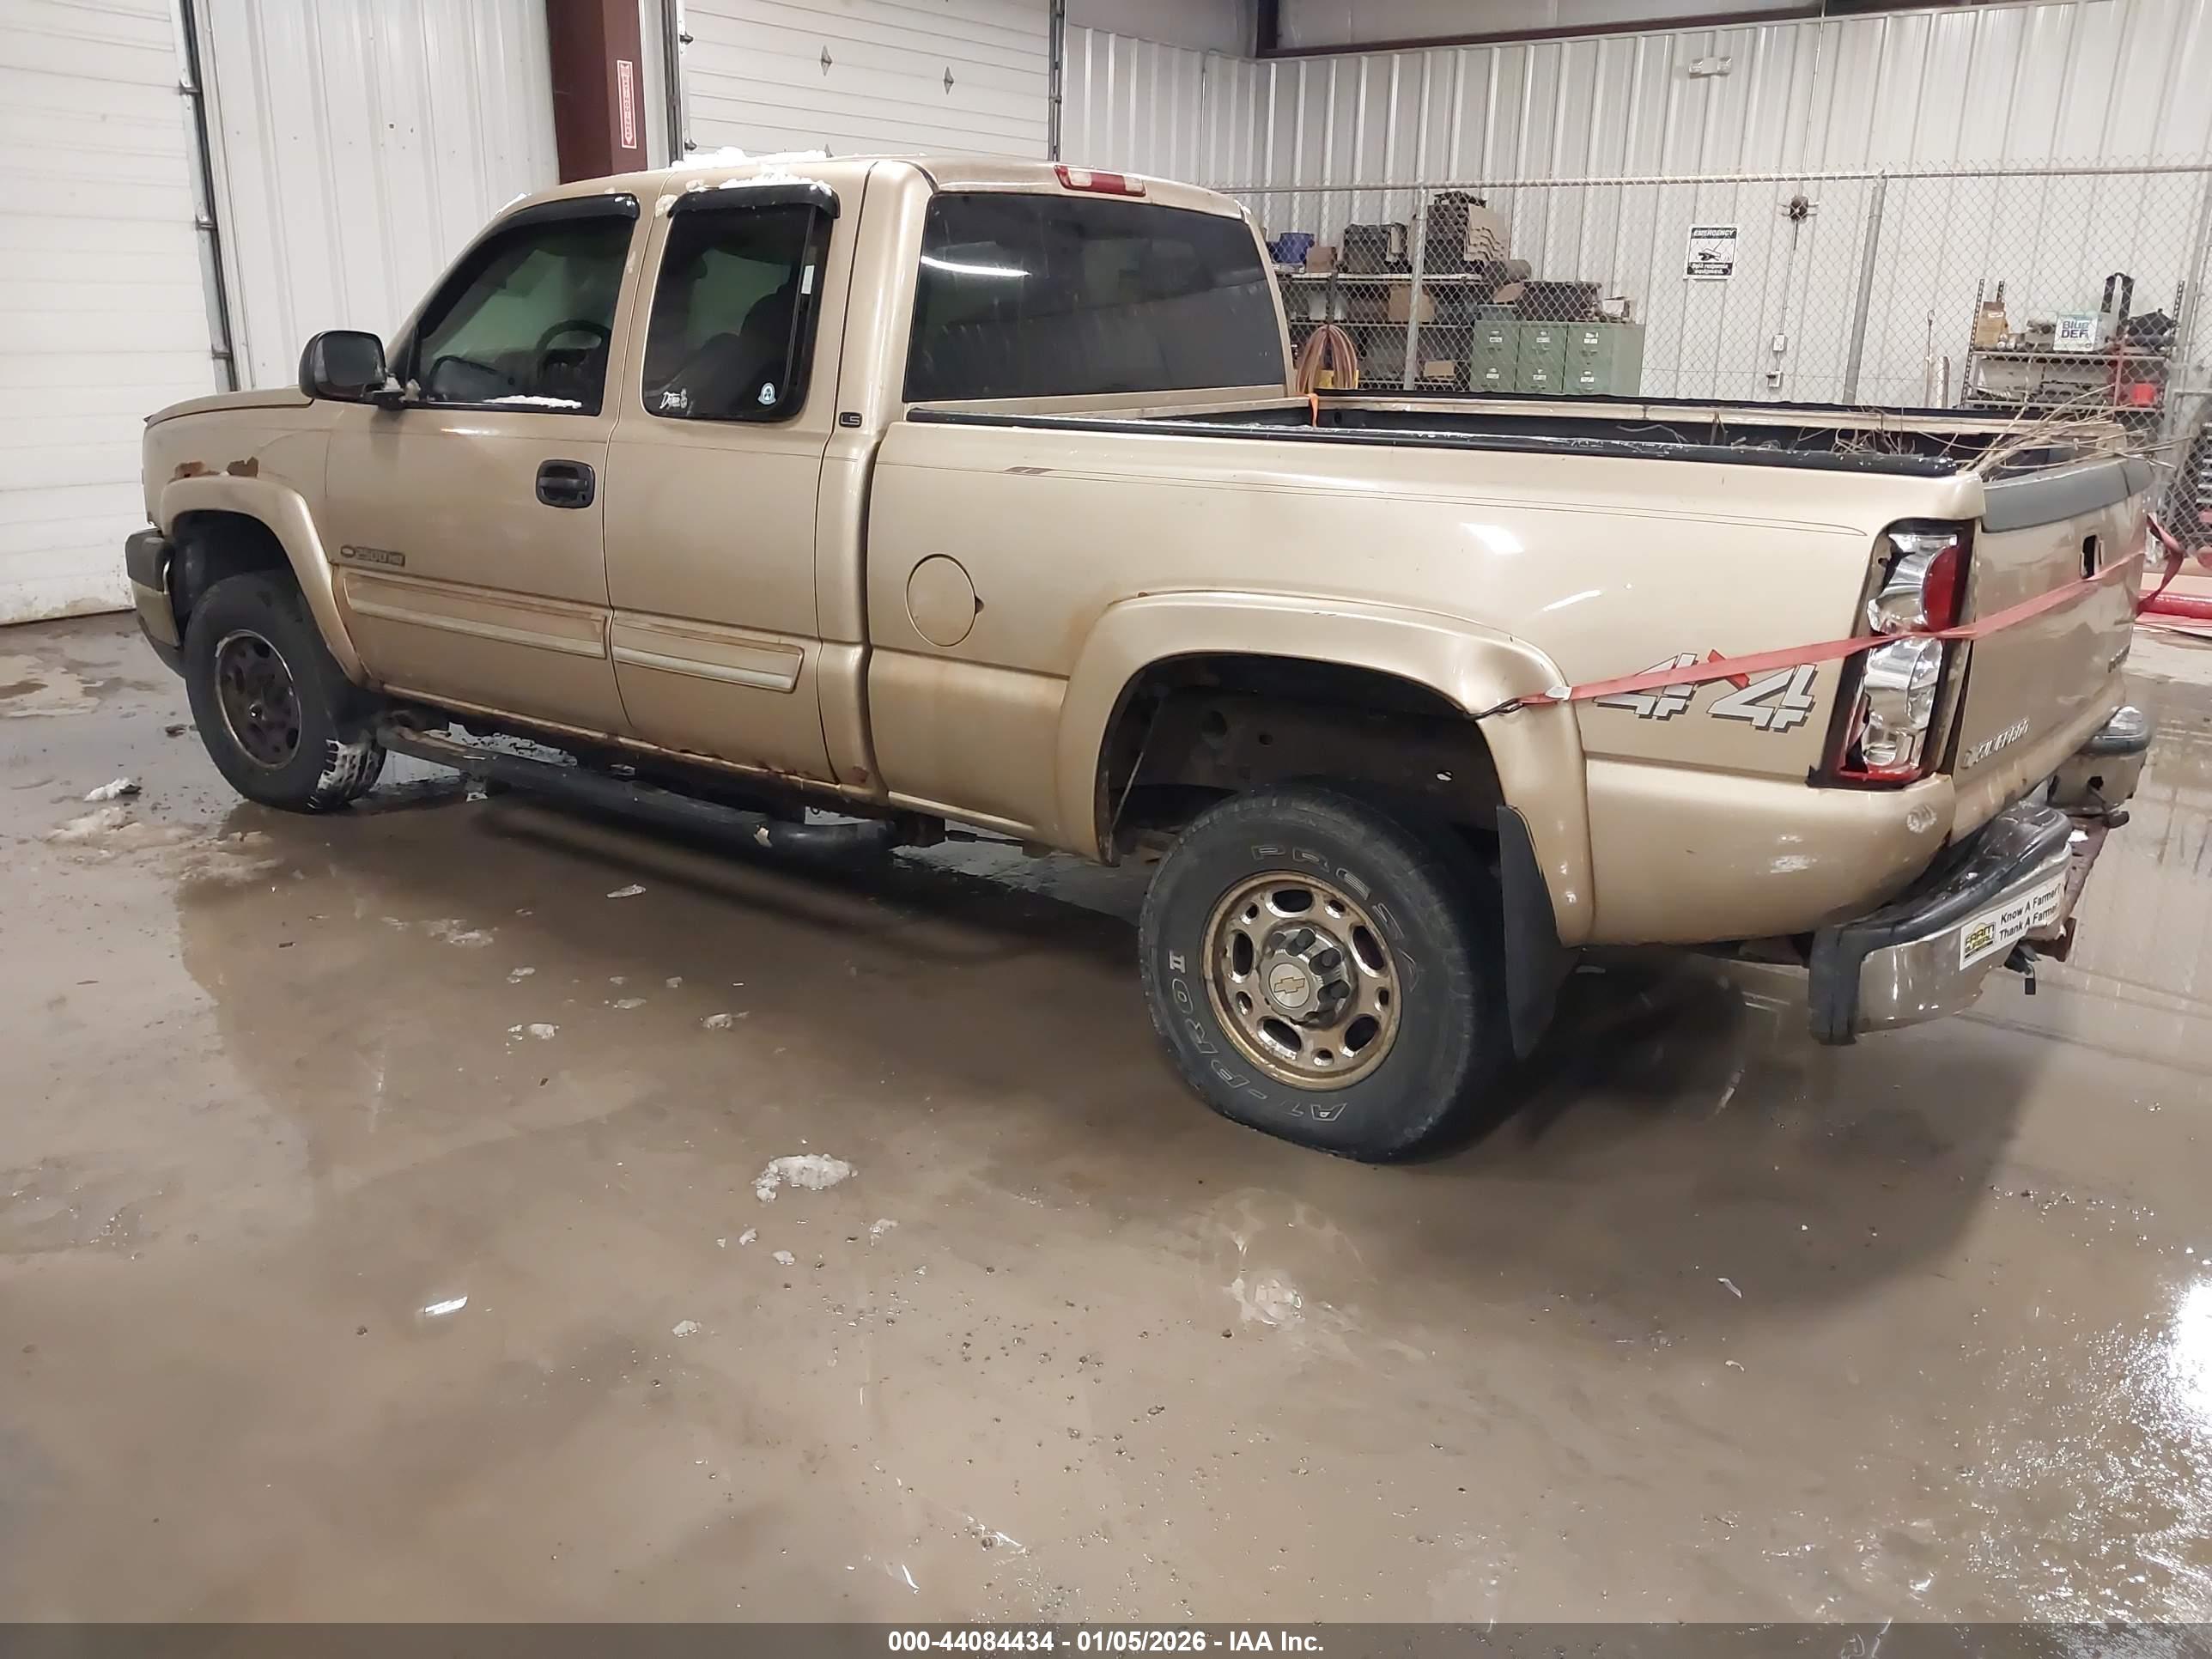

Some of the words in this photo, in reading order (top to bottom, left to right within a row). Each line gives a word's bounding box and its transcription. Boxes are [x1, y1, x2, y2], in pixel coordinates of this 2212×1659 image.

[1693, 228, 1735, 237] EMERGENCY
[2061, 329, 2089, 338] DEF
[841, 415, 860, 426] LS
[2000, 907, 2024, 926] Know
[2025, 901, 2031, 913] A
[1999, 921, 2023, 941] Thank
[2024, 915, 2031, 927] A
